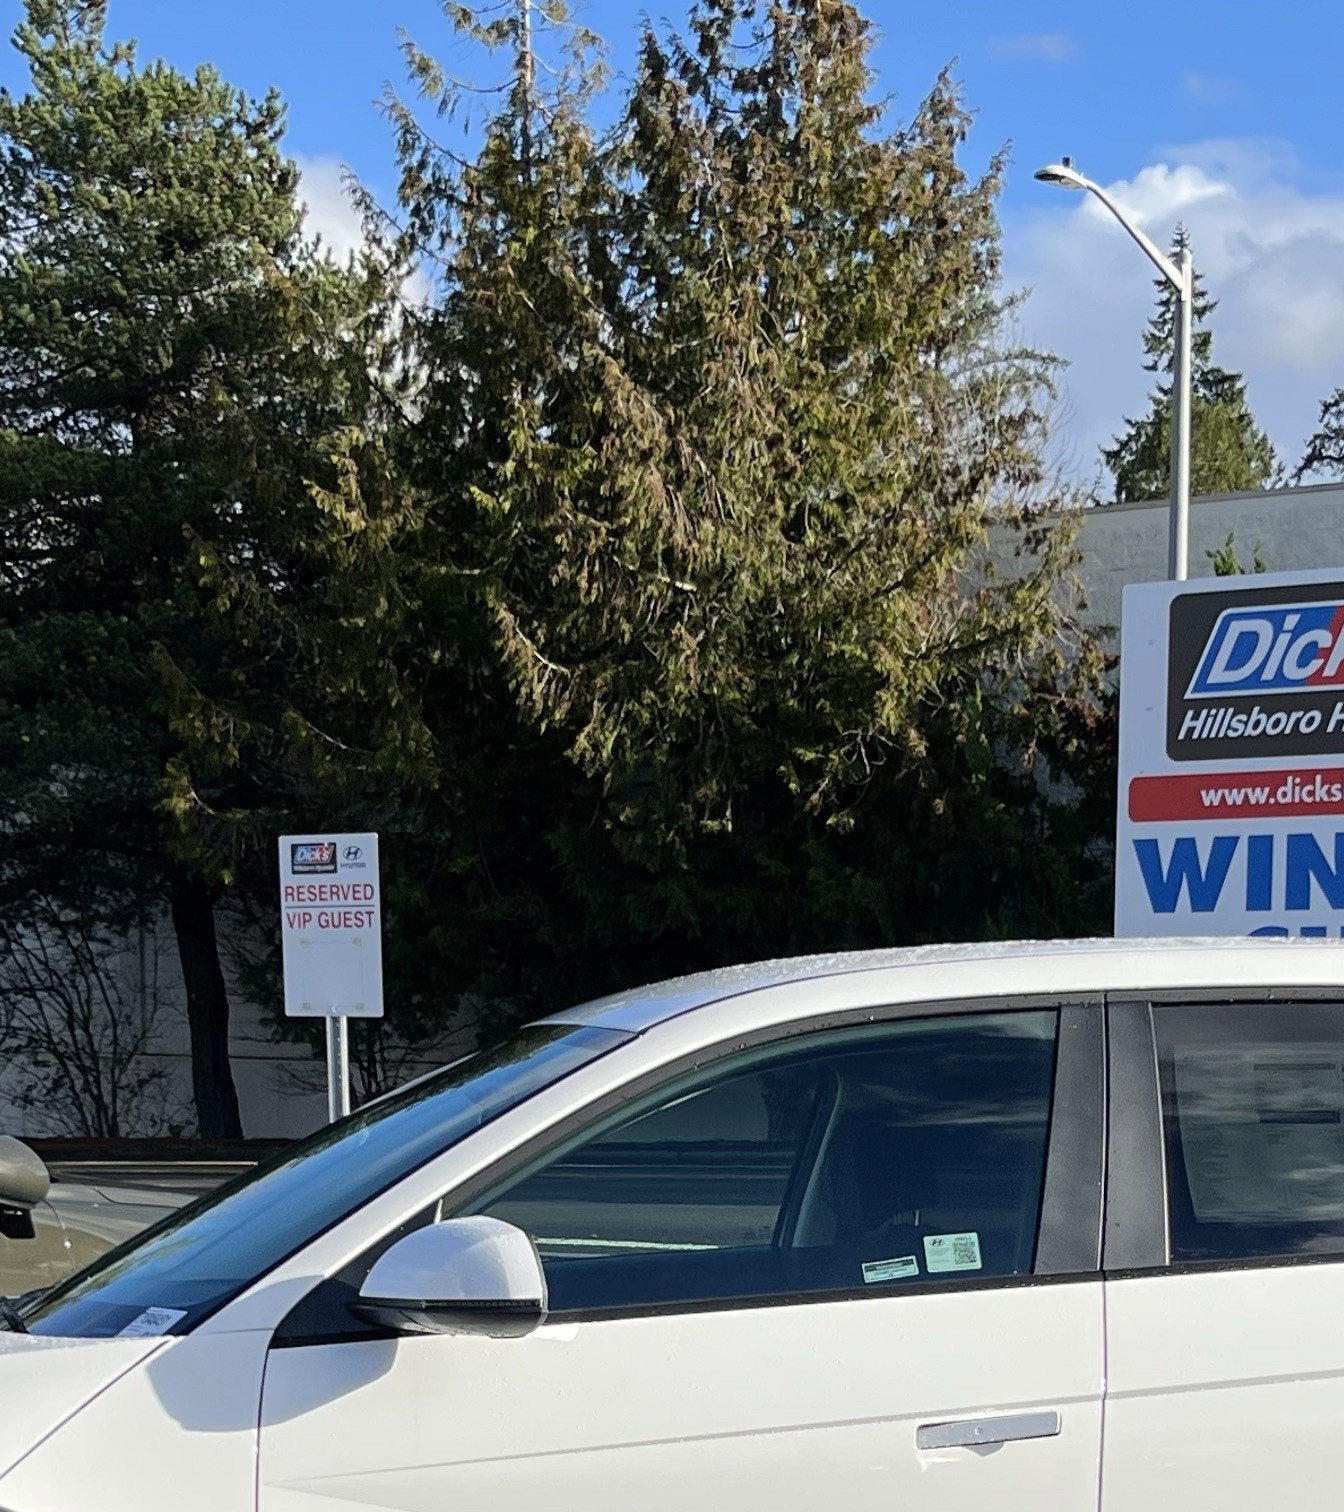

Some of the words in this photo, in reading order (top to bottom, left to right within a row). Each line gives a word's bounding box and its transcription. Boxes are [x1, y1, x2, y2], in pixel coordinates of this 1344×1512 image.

[1177, 706, 1321, 740] Hillsboro
[285, 884, 375, 902] RESERVED
[286, 912, 312, 930] VIP
[318, 911, 375, 929] GUEST
